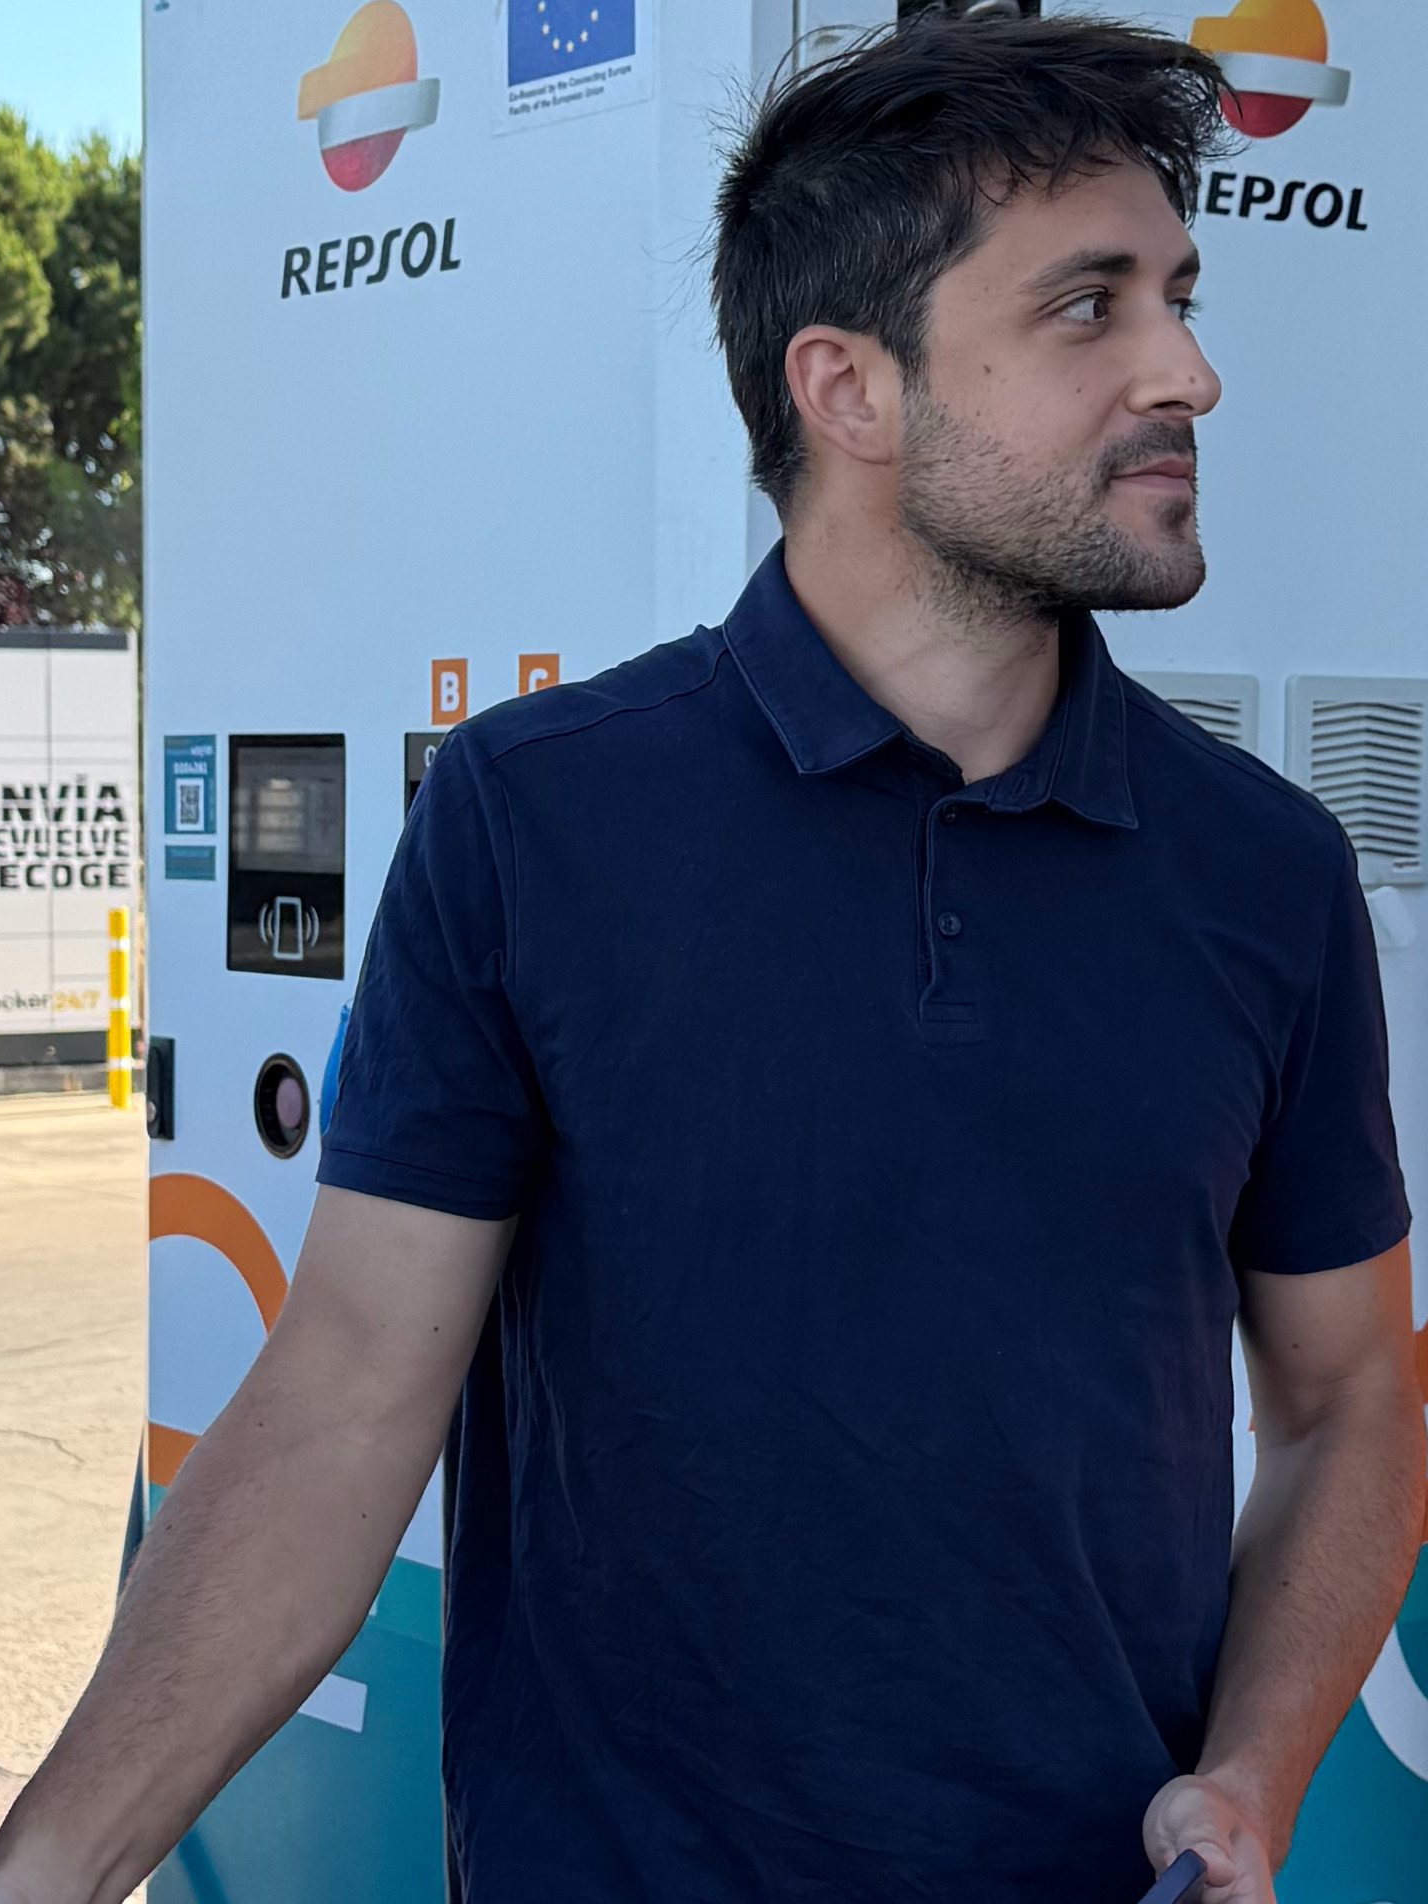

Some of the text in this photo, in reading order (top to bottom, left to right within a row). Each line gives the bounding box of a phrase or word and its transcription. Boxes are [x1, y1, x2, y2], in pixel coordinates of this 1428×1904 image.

[1204, 171, 1368, 232] EPSOL
[281, 218, 461, 299] REPSOL
[440, 671, 460, 713] B
